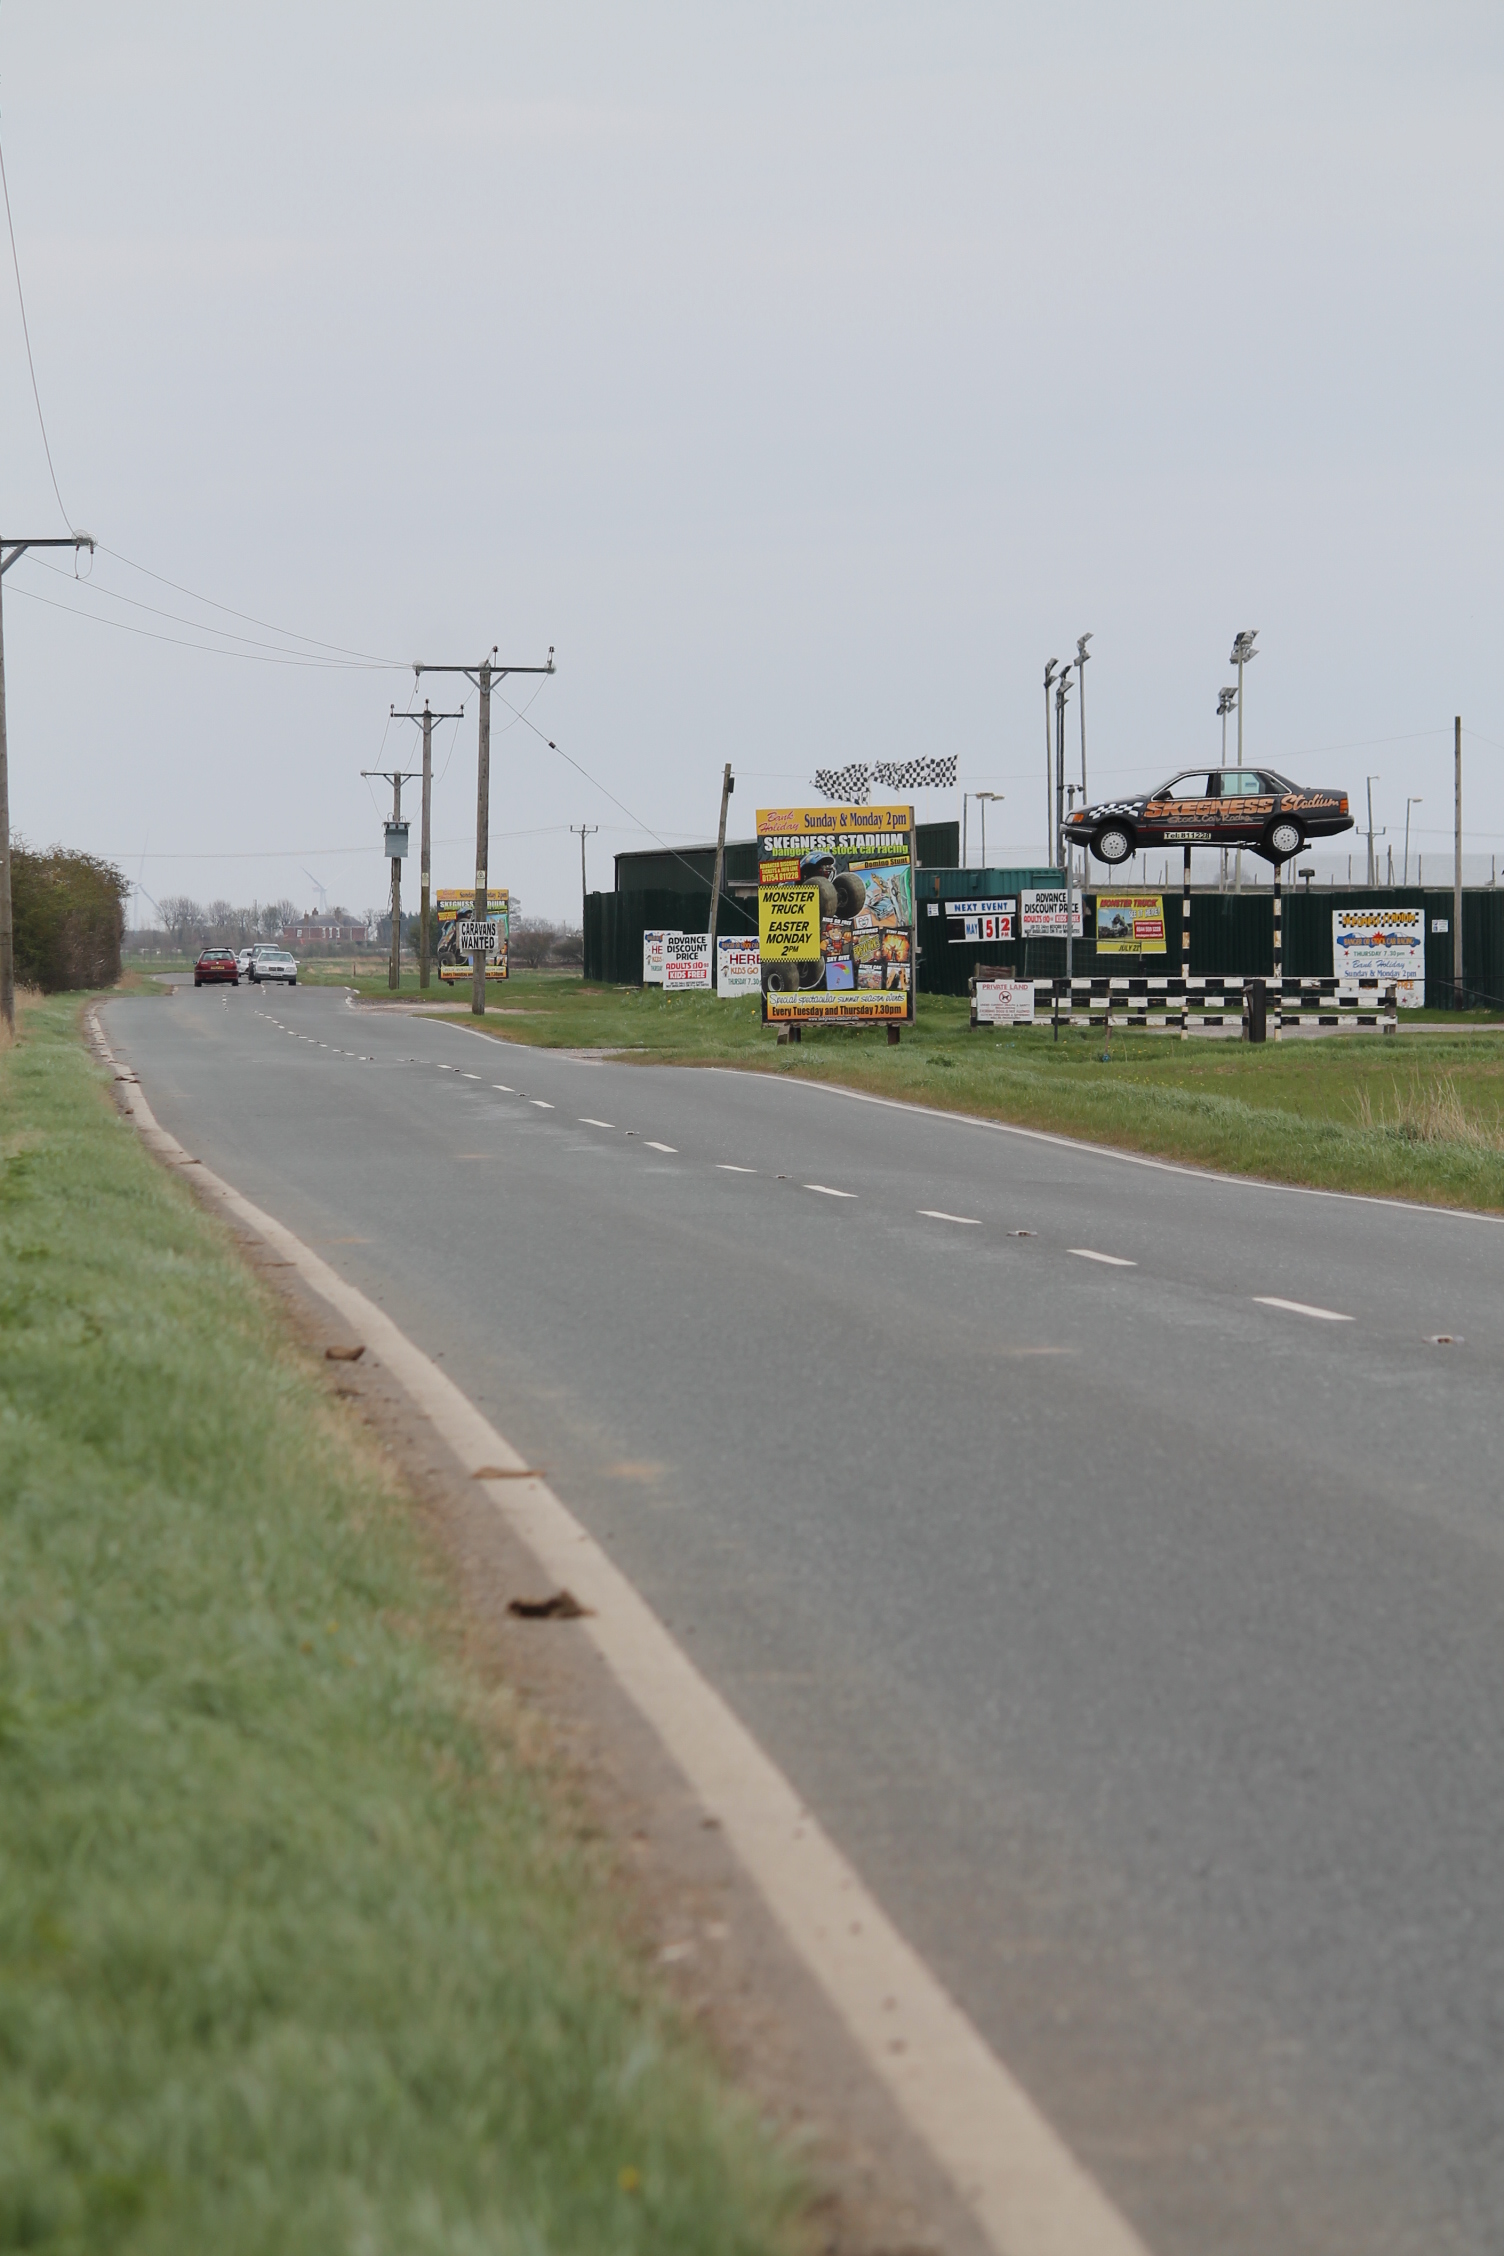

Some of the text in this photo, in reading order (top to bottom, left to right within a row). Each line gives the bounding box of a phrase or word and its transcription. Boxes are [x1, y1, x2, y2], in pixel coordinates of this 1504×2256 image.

[1144, 794, 1339, 818] SKEGNESS Stadium
[767, 810, 794, 822] Bank
[804, 811, 907, 830] Sunday & Monday 2pm
[758, 821, 799, 833] Holiday
[764, 834, 903, 851] SKEGNESS STADIUM
[772, 846, 811, 856] bangers
[832, 845, 858, 855] stock
[860, 846, 874, 854] car
[877, 844, 908, 854] racing
[864, 860, 889, 868] Domino
[763, 892, 814, 902] MONSTER
[1036, 893, 1066, 903] ADVANCE
[955, 902, 1008, 912] NEXT EVENT
[1100, 899, 1158, 907] MONSTER TRUCK
[771, 904, 805, 914] TRUCK
[1025, 904, 1079, 914] DISCOUNT PRCE
[1343, 912, 1415, 926] SKEGNESS STADIUM
[462, 923, 496, 936] CARAVANS
[769, 922, 809, 931] EASTER
[966, 924, 977, 934] MAY
[986, 919, 993, 938] 5
[1001, 918, 1010, 931] 2
[461, 937, 494, 948] WANTED
[668, 936, 706, 944] ADVANCE
[766, 934, 812, 944] MONDAY
[652, 946, 663, 954] HE
[667, 944, 708, 953] DISCOUNT
[781, 946, 799, 956] 2PM
[1376, 960, 1405, 969] Holiday
[1378, 969, 1400, 978] Monday
[1402, 970, 1416, 978] 2pm
[1397, 981, 1414, 990] FREE
[770, 993, 798, 1006] Special
[772, 1005, 901, 1018] Every Tuesday and Thursday 7.30pm
